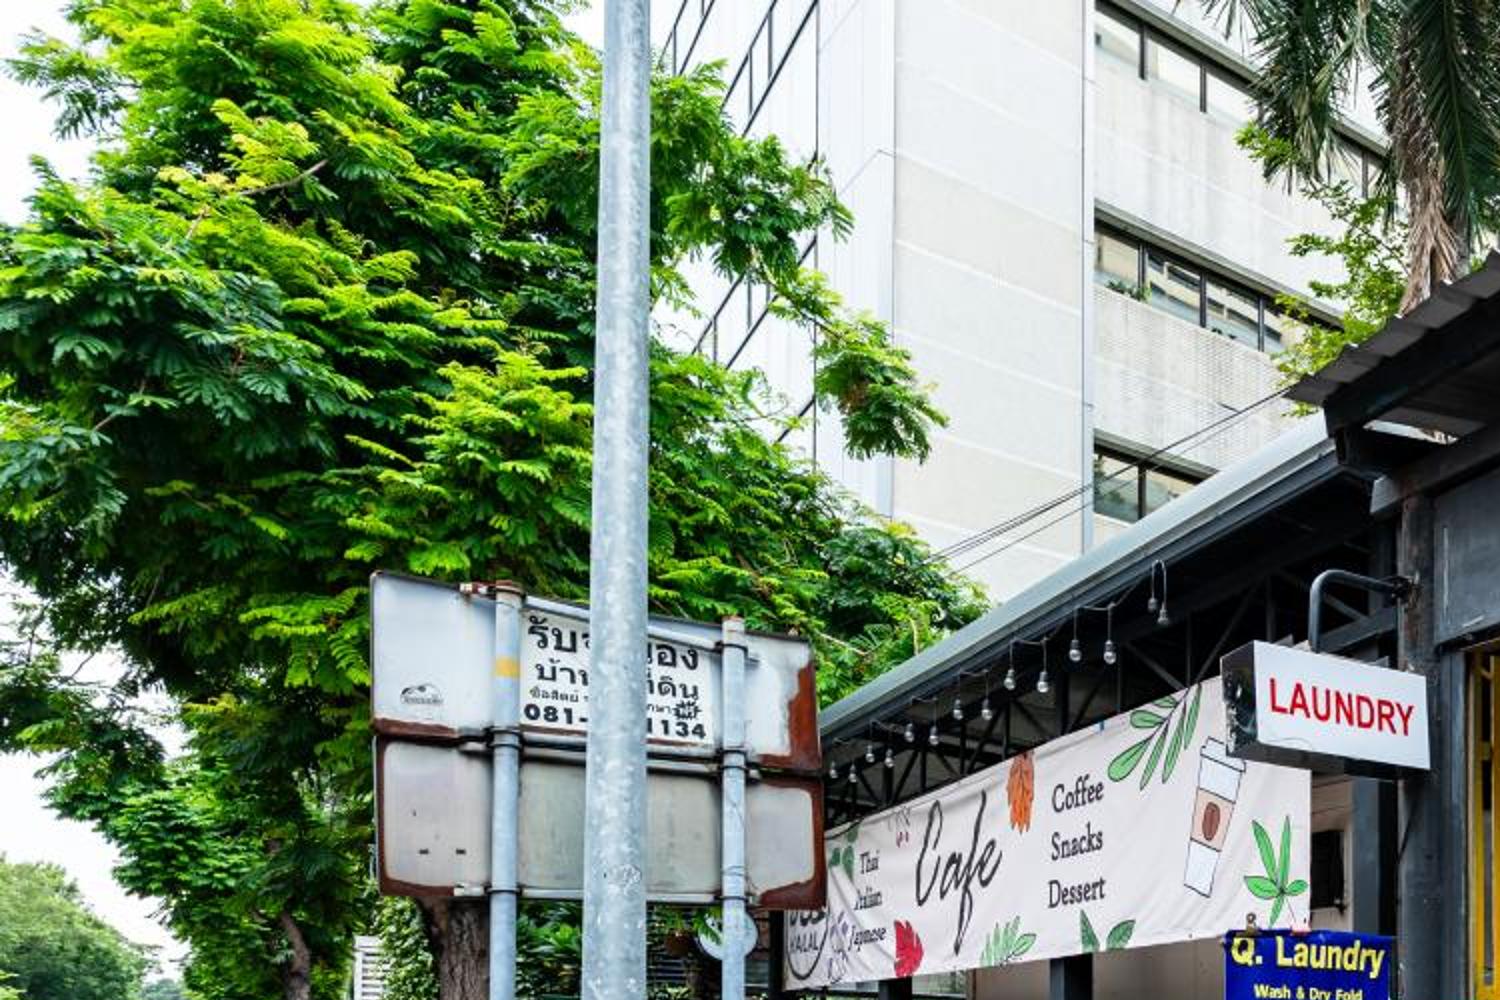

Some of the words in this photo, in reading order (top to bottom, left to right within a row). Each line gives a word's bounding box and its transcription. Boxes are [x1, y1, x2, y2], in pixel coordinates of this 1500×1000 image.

[1269, 677, 1415, 737] LAUNDRY
[1051, 774, 1104, 813] Coffee
[1051, 821, 1103, 861] Snacks
[916, 790, 1003, 956] Cafe
[1048, 877, 1106, 908] Dessert
[1231, 937, 1264, 966] Q.
[1275, 935, 1385, 979] Laundry
[1254, 984, 1291, 999] Wash
[1296, 986, 1305, 1000] &
